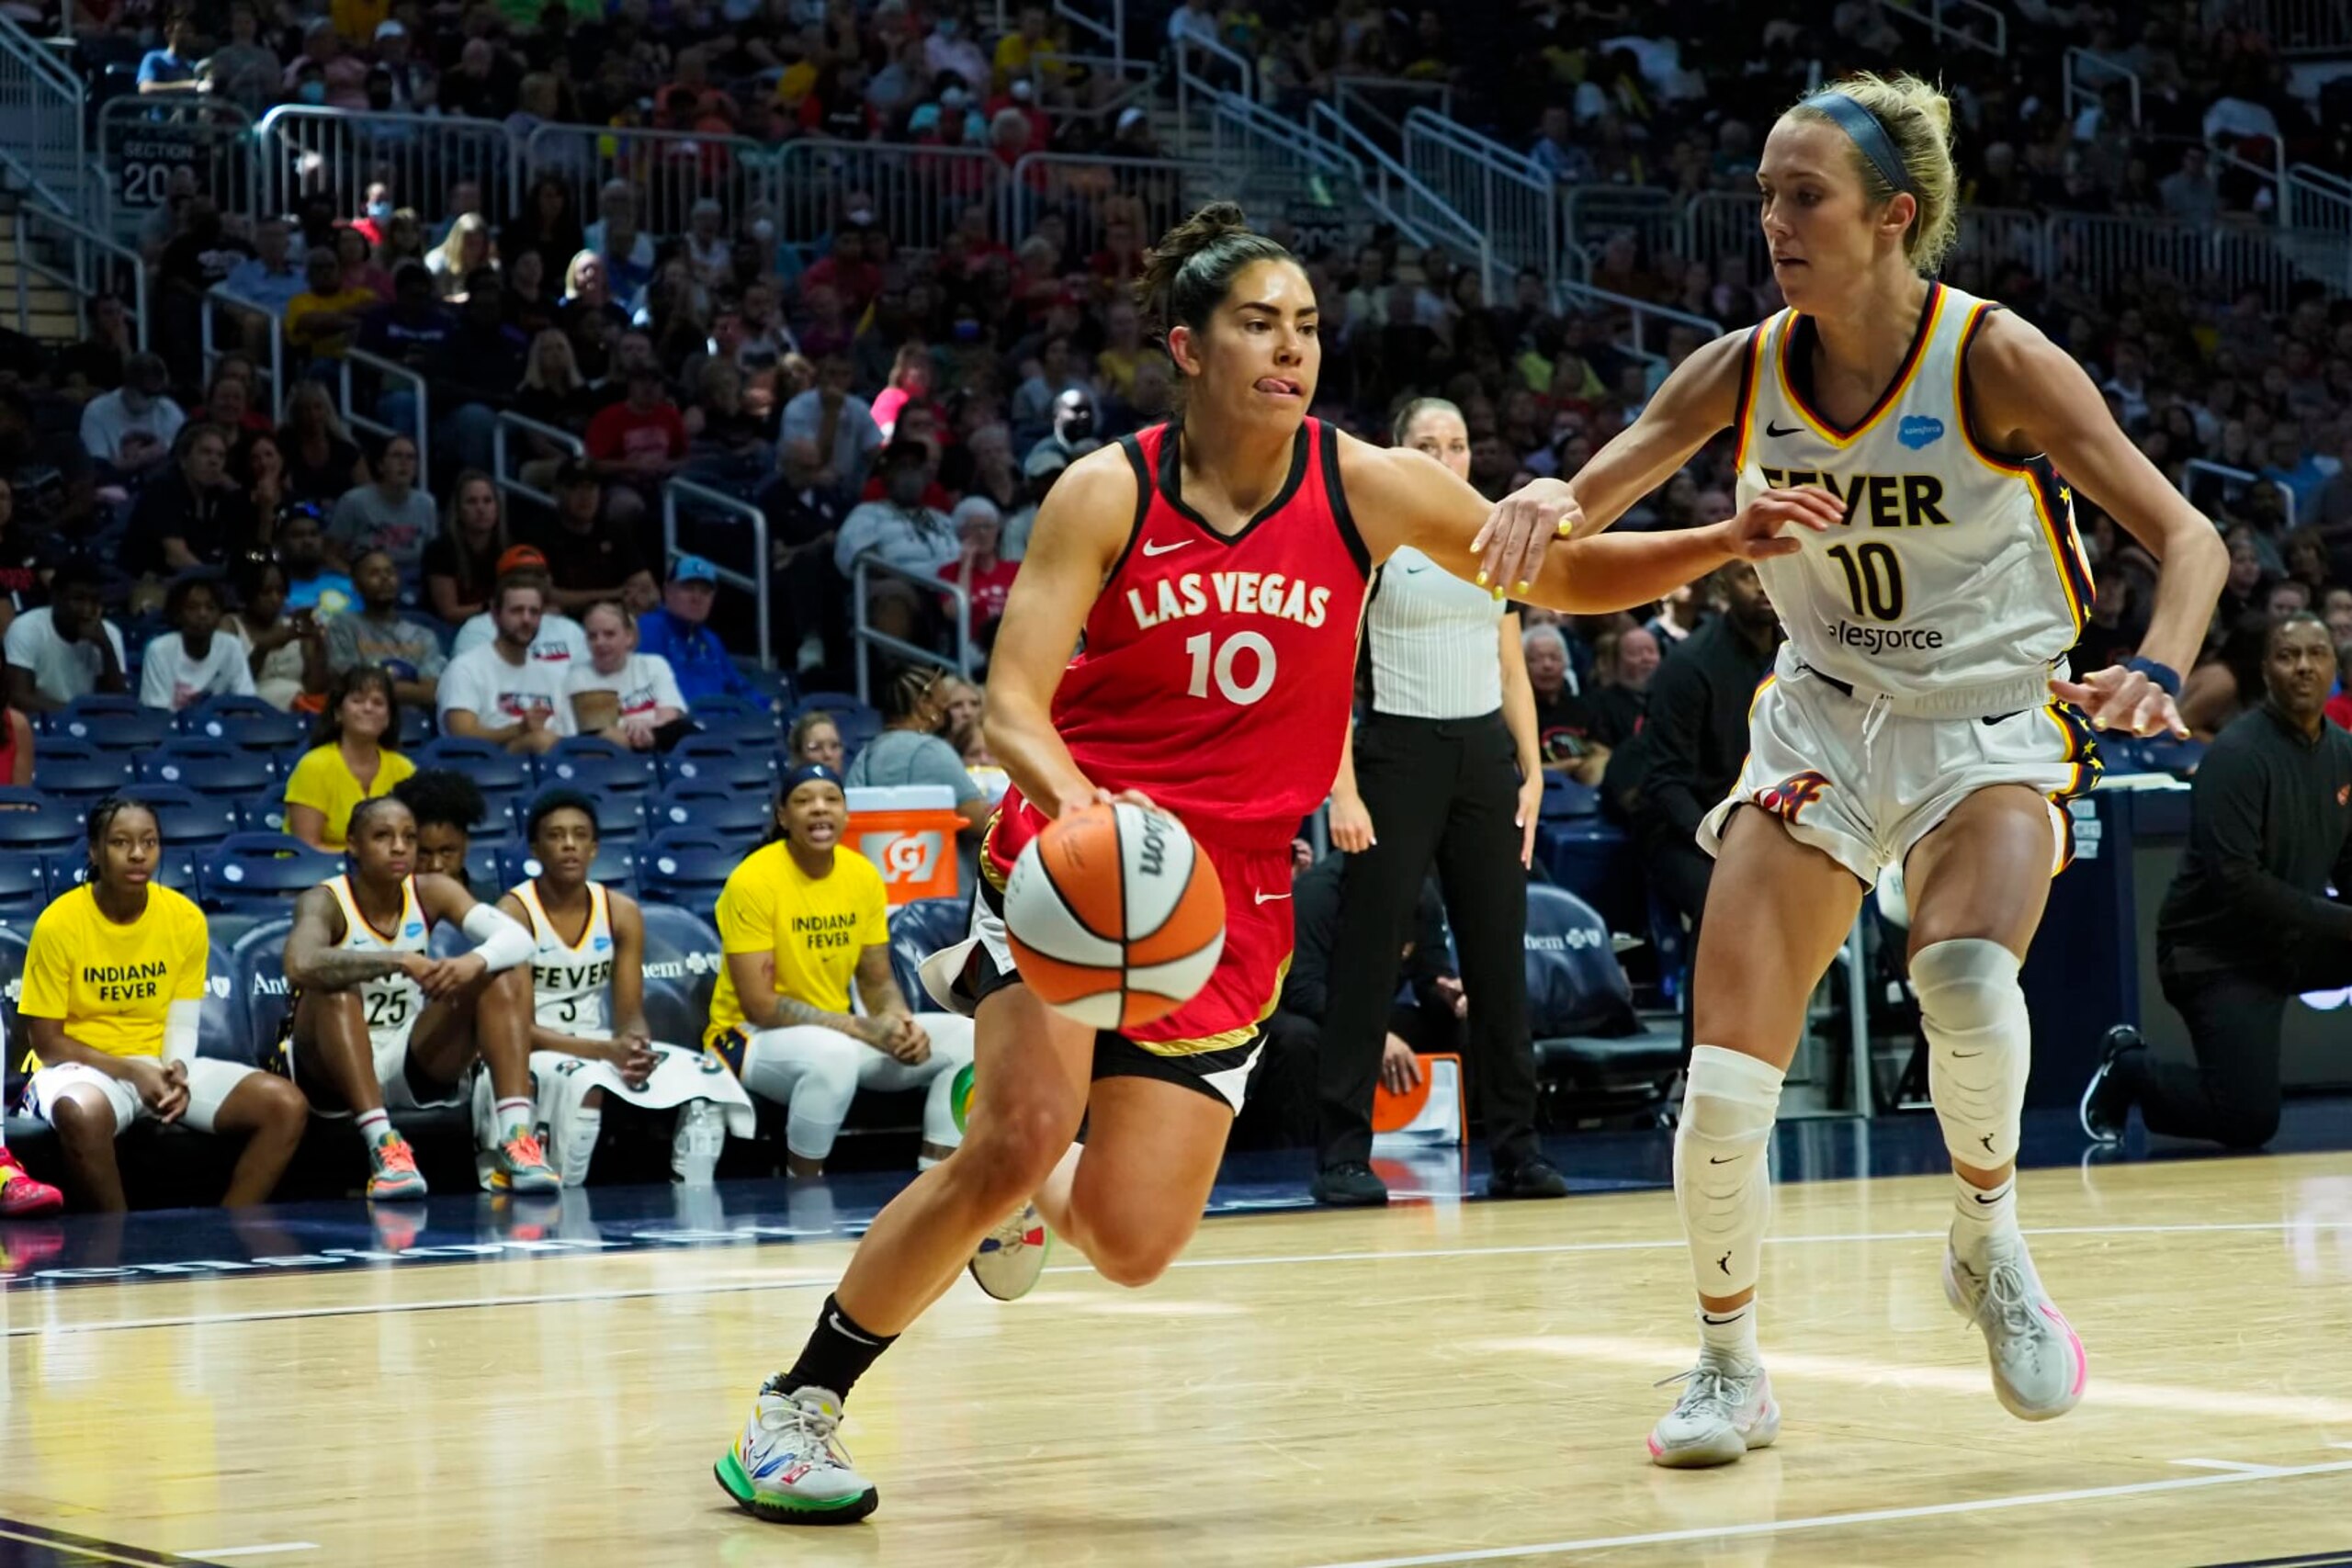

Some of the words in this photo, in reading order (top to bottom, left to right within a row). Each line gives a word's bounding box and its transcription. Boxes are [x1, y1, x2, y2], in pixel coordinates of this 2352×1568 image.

[122, 140, 196, 160] SECTION
[123, 162, 195, 204] 20
[1826, 543, 1904, 621] 10
[1126, 572, 1208, 630] LAS
[1211, 571, 1331, 629] VEGAS
[1185, 631, 1277, 705] 10
[791, 911, 857, 932] INDIANA
[807, 931, 850, 950] FEVER
[84, 961, 167, 983] INDIANA
[532, 960, 611, 989] FEVER
[100, 982, 157, 1001] FEVER
[368, 989, 407, 1025] 25
